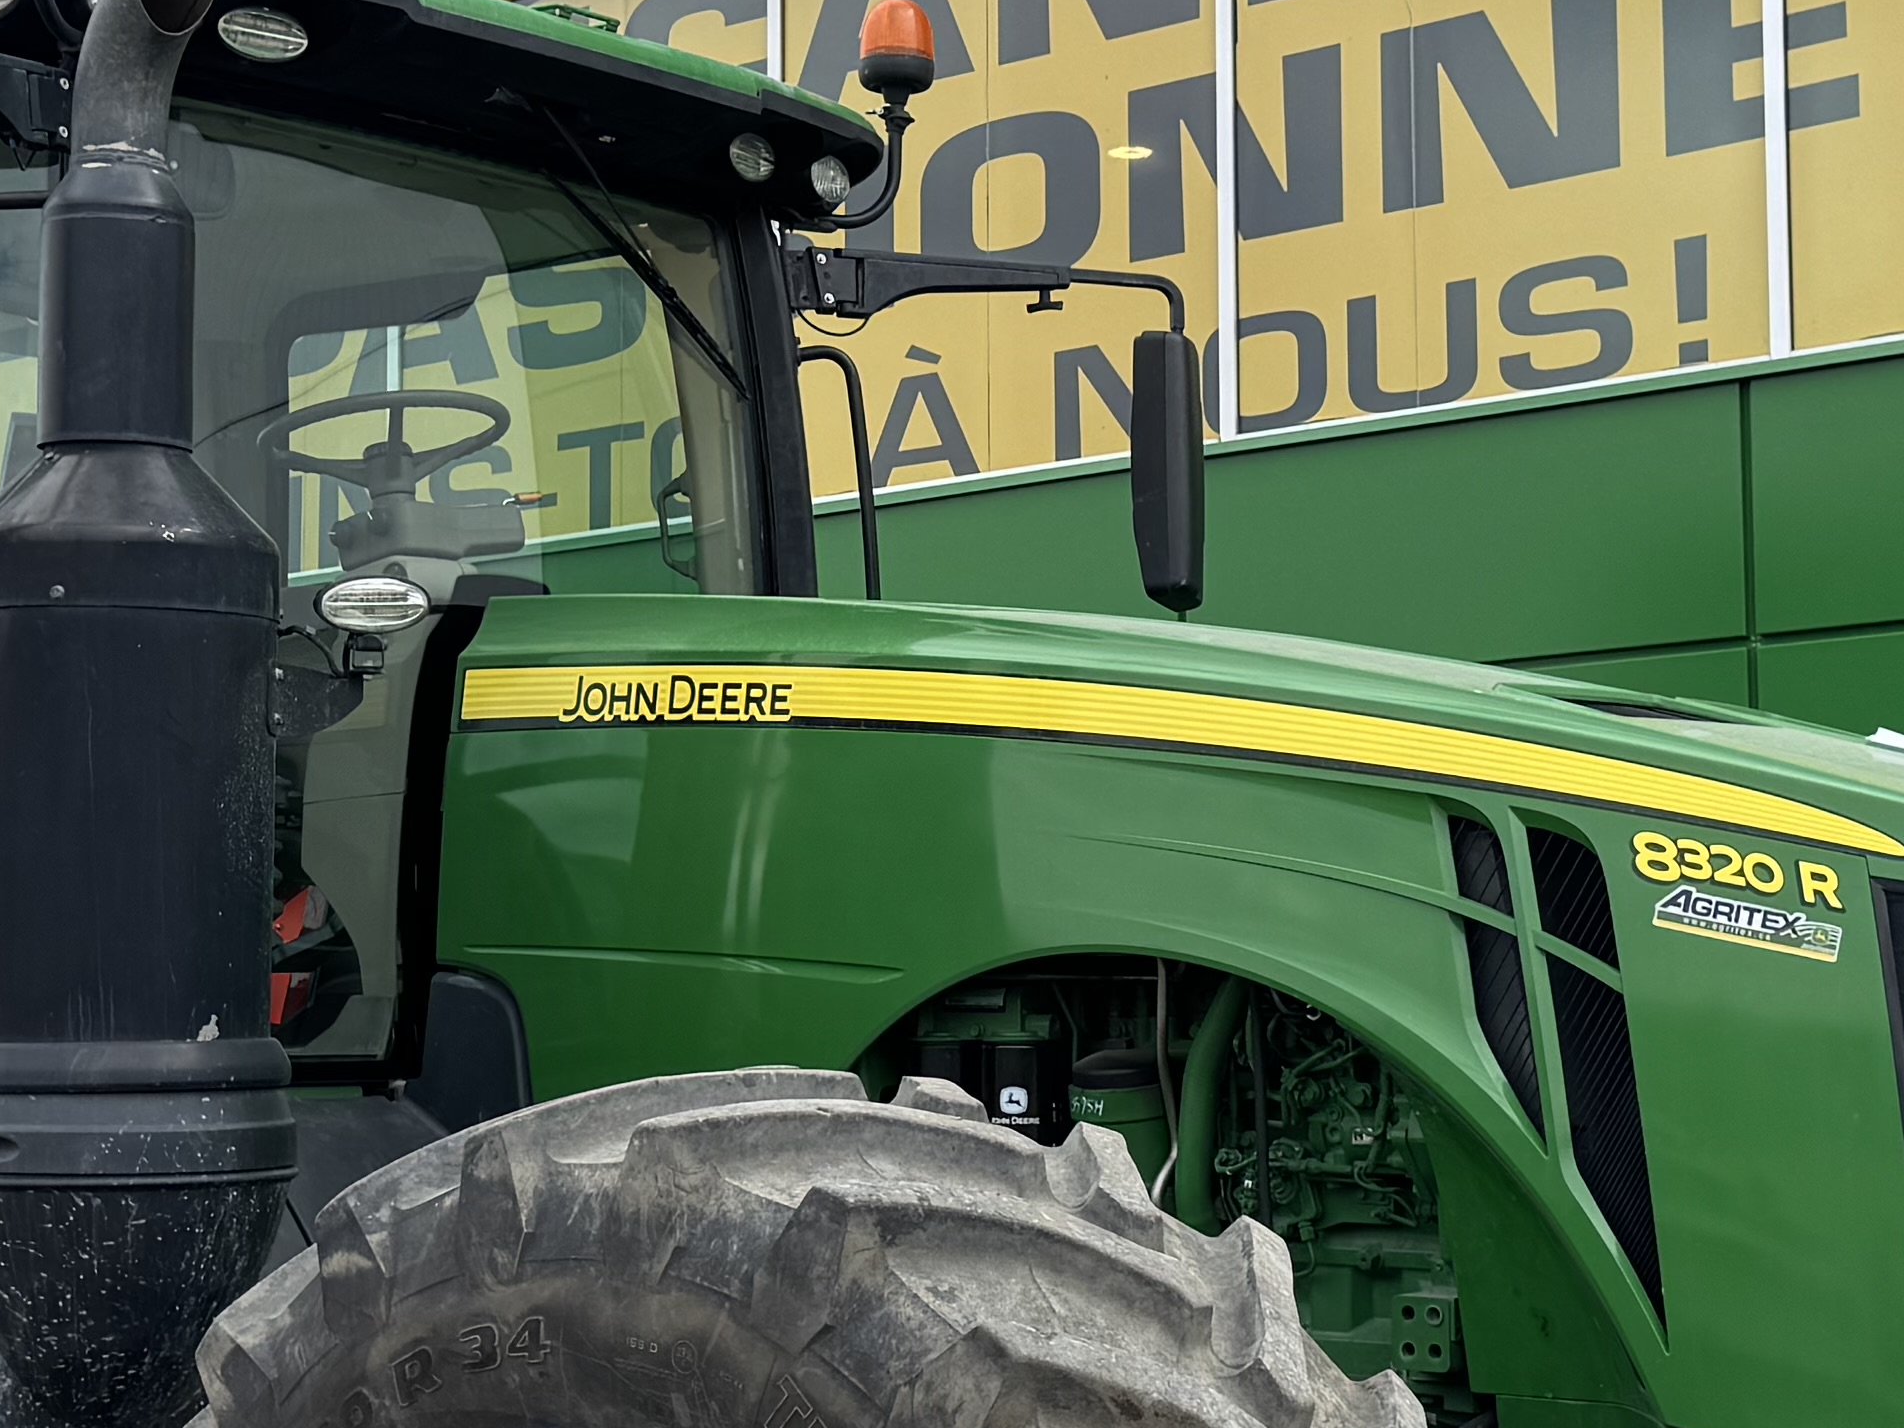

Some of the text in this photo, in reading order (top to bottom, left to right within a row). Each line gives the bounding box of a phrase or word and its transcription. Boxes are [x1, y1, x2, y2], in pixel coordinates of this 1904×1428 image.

[872, 344, 982, 487] À
[560, 674, 793, 717] JOHN DEERE
[1630, 830, 1845, 911] 8320 R
[1660, 888, 1803, 938] AGRITEX
[388, 1345, 443, 1408] R
[457, 1315, 554, 1374] 34
